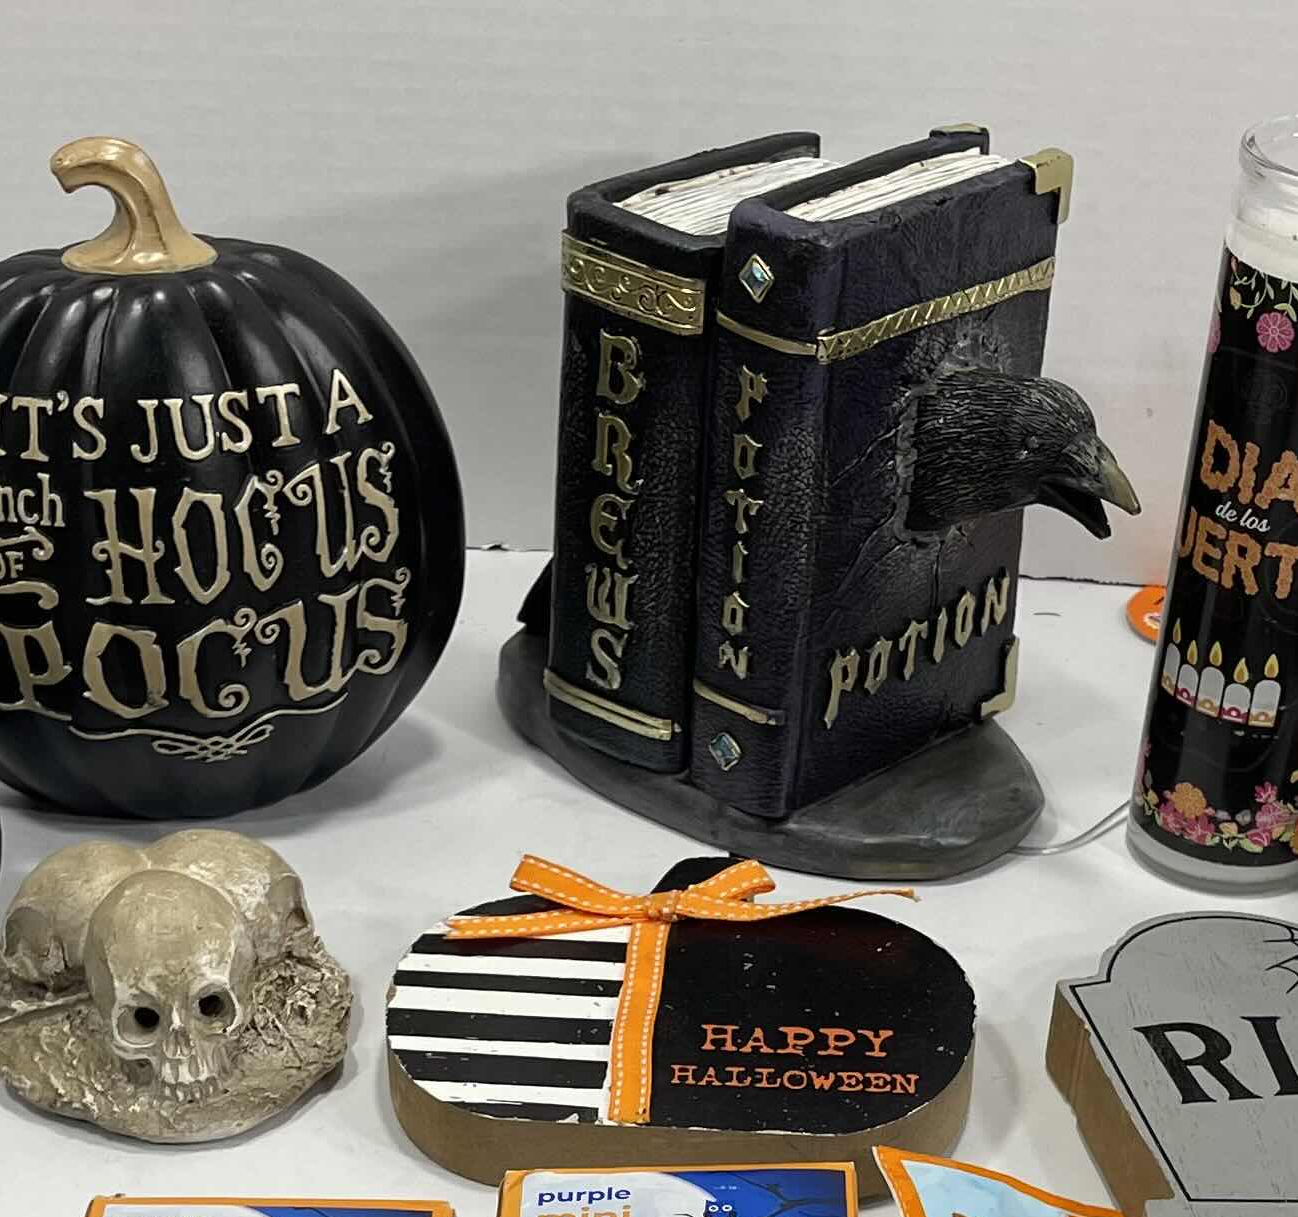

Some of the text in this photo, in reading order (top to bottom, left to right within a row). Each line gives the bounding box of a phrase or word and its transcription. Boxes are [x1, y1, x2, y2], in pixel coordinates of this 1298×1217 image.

[131, 383, 302, 463] JUST
[323, 369, 372, 435] A
[83, 442, 400, 605] HOCUS
[584, 329, 647, 691] BREWS
[717, 364, 769, 681] POTION
[1215, 501, 1271, 532] de los
[824, 569, 1009, 729] POTION
[671, 1064, 920, 1094] HALLOWEEN
[701, 1024, 894, 1057] HAPPY
[537, 1186, 631, 1206] purple
